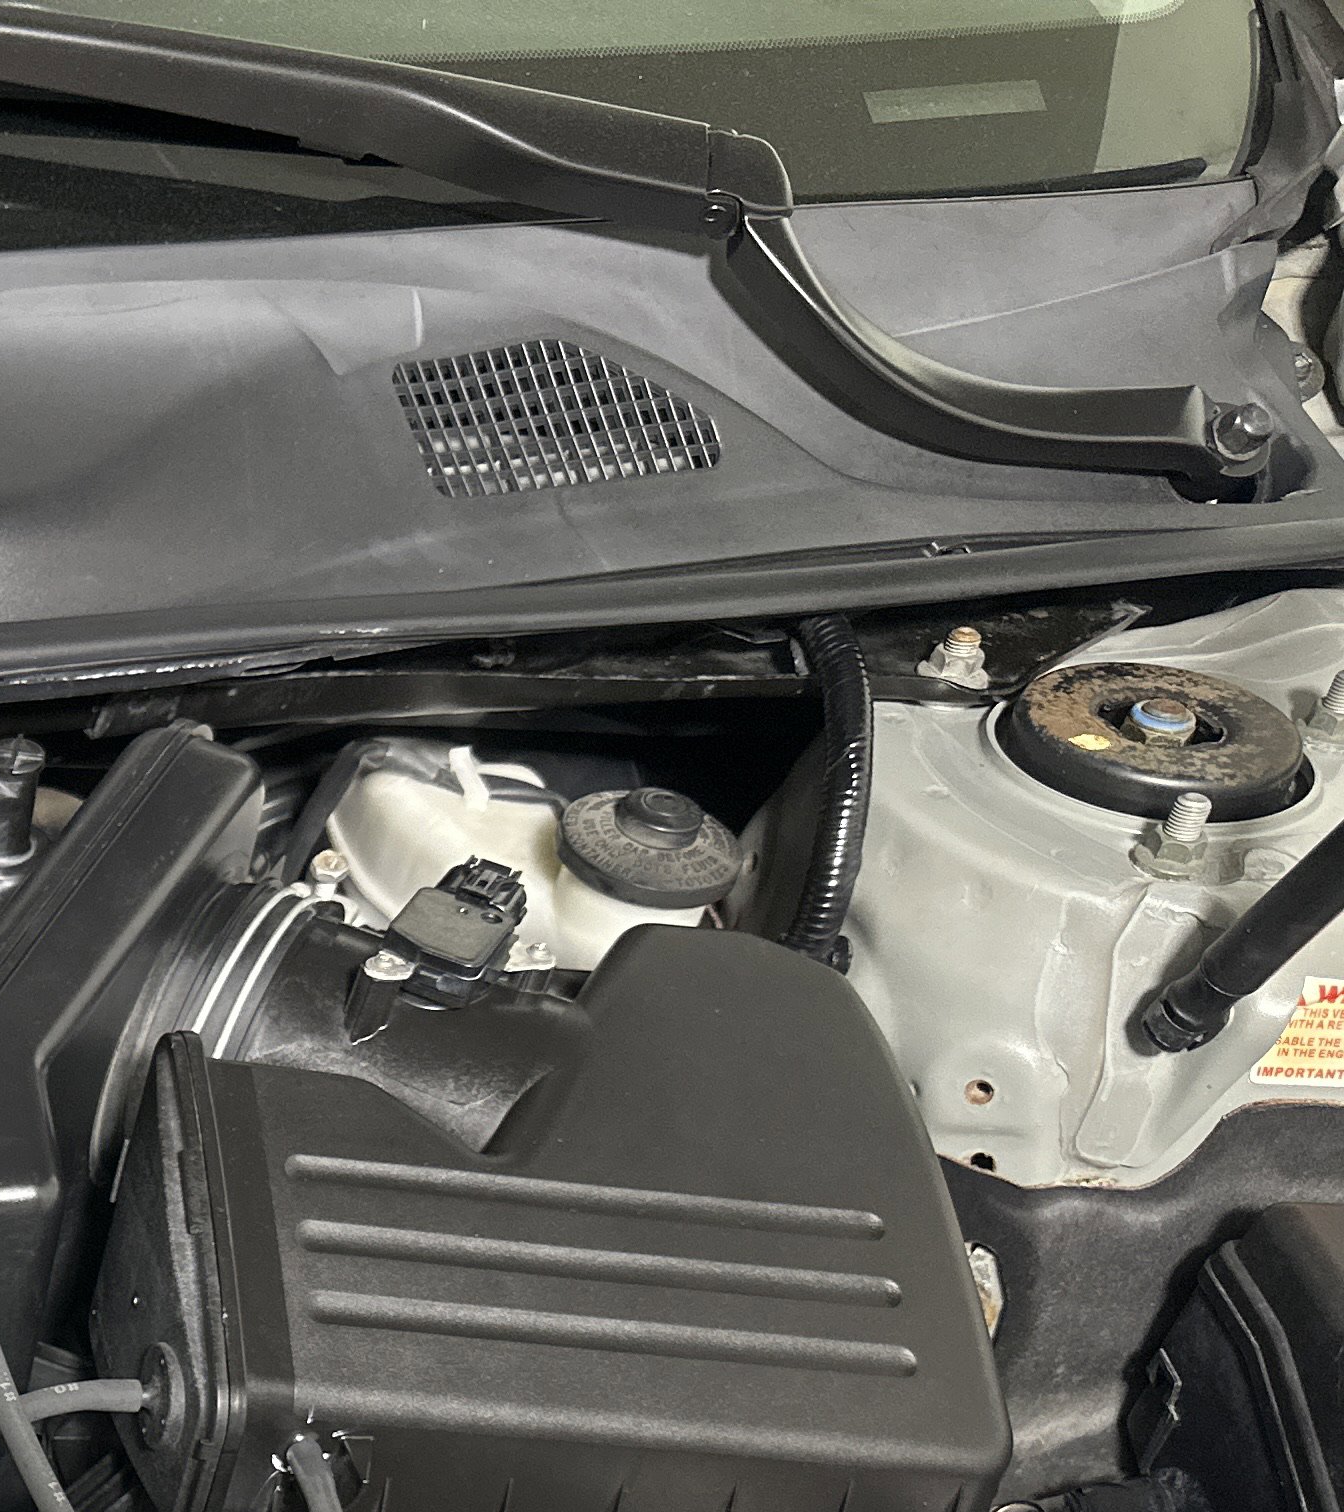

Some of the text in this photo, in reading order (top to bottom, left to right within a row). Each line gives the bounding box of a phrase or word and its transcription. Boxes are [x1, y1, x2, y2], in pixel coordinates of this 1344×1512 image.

[1303, 1008, 1329, 1018] THIS
[1316, 1020, 1324, 1029] A
[1318, 1038, 1341, 1047] THE
[1277, 1048, 1289, 1056] IN
[1293, 1049, 1316, 1058] THE
